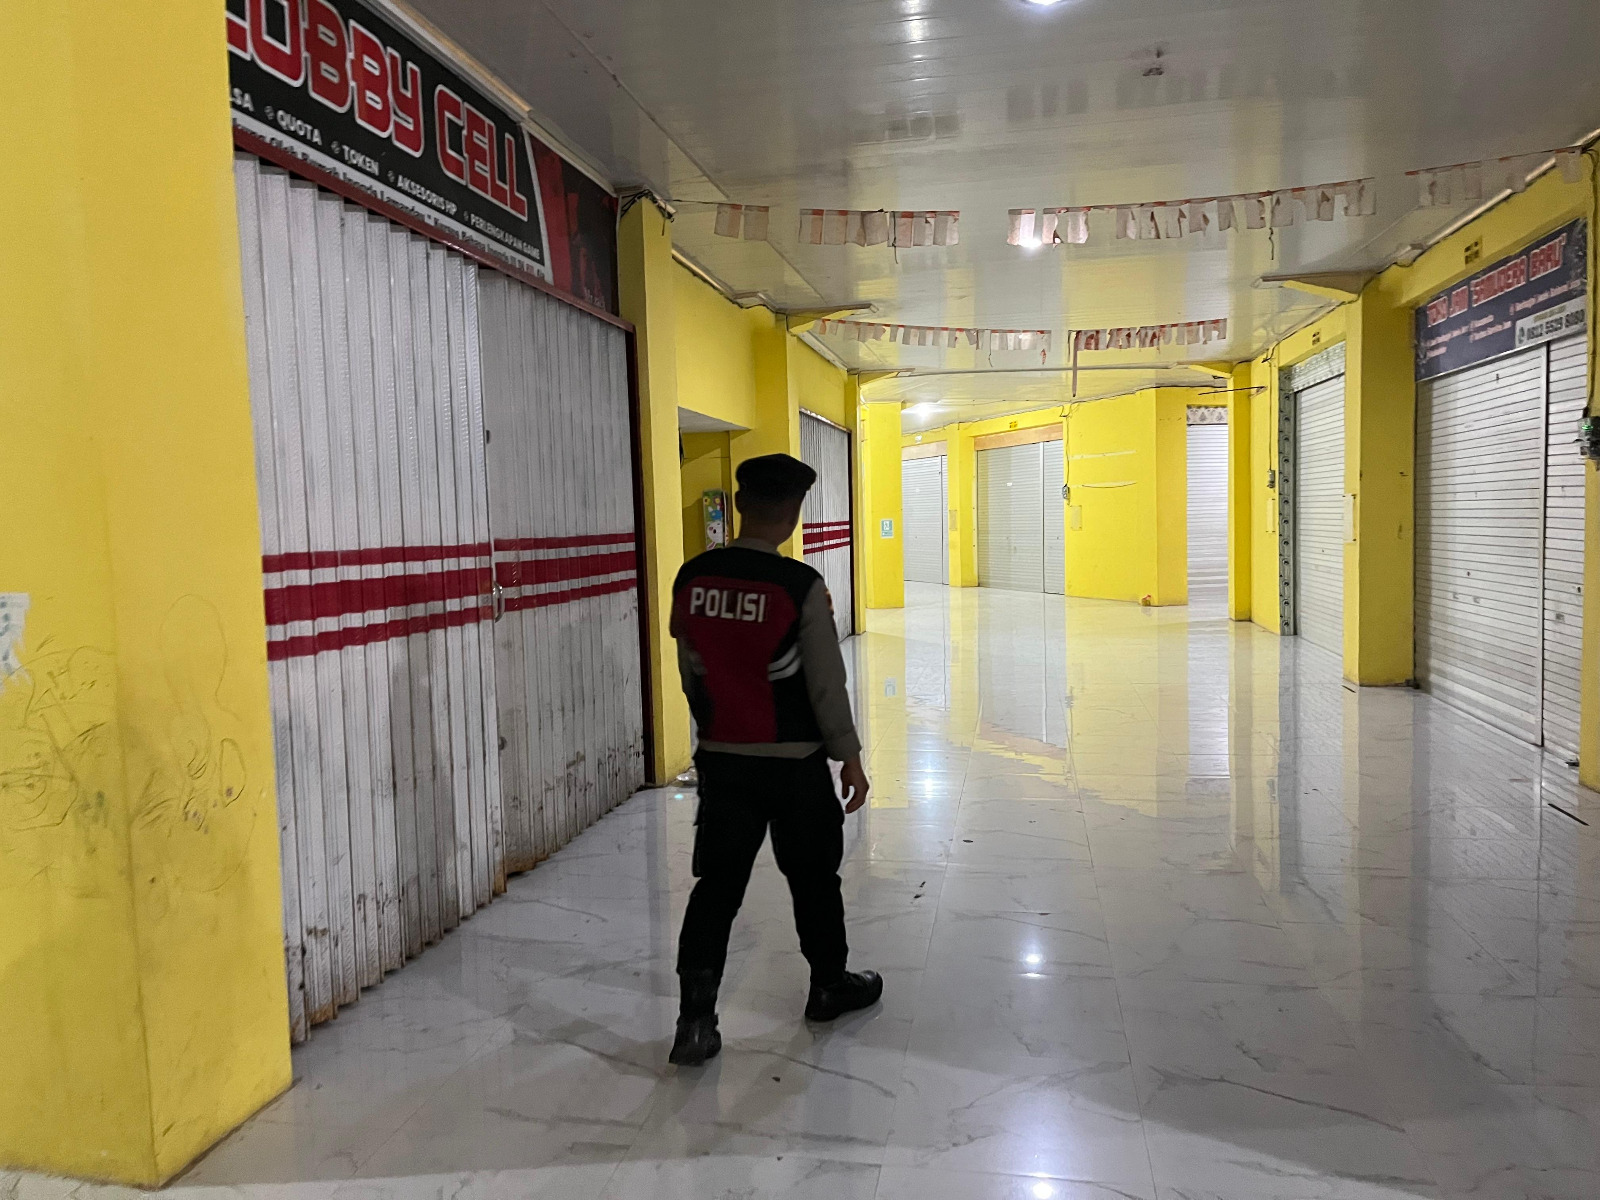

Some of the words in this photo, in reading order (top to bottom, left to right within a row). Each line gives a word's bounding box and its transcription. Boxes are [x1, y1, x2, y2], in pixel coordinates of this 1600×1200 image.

[276, 110, 322, 145] QUOTA
[341, 145, 380, 176] TOKEN
[433, 84, 528, 222] CELL
[690, 587, 766, 623] POLISI
